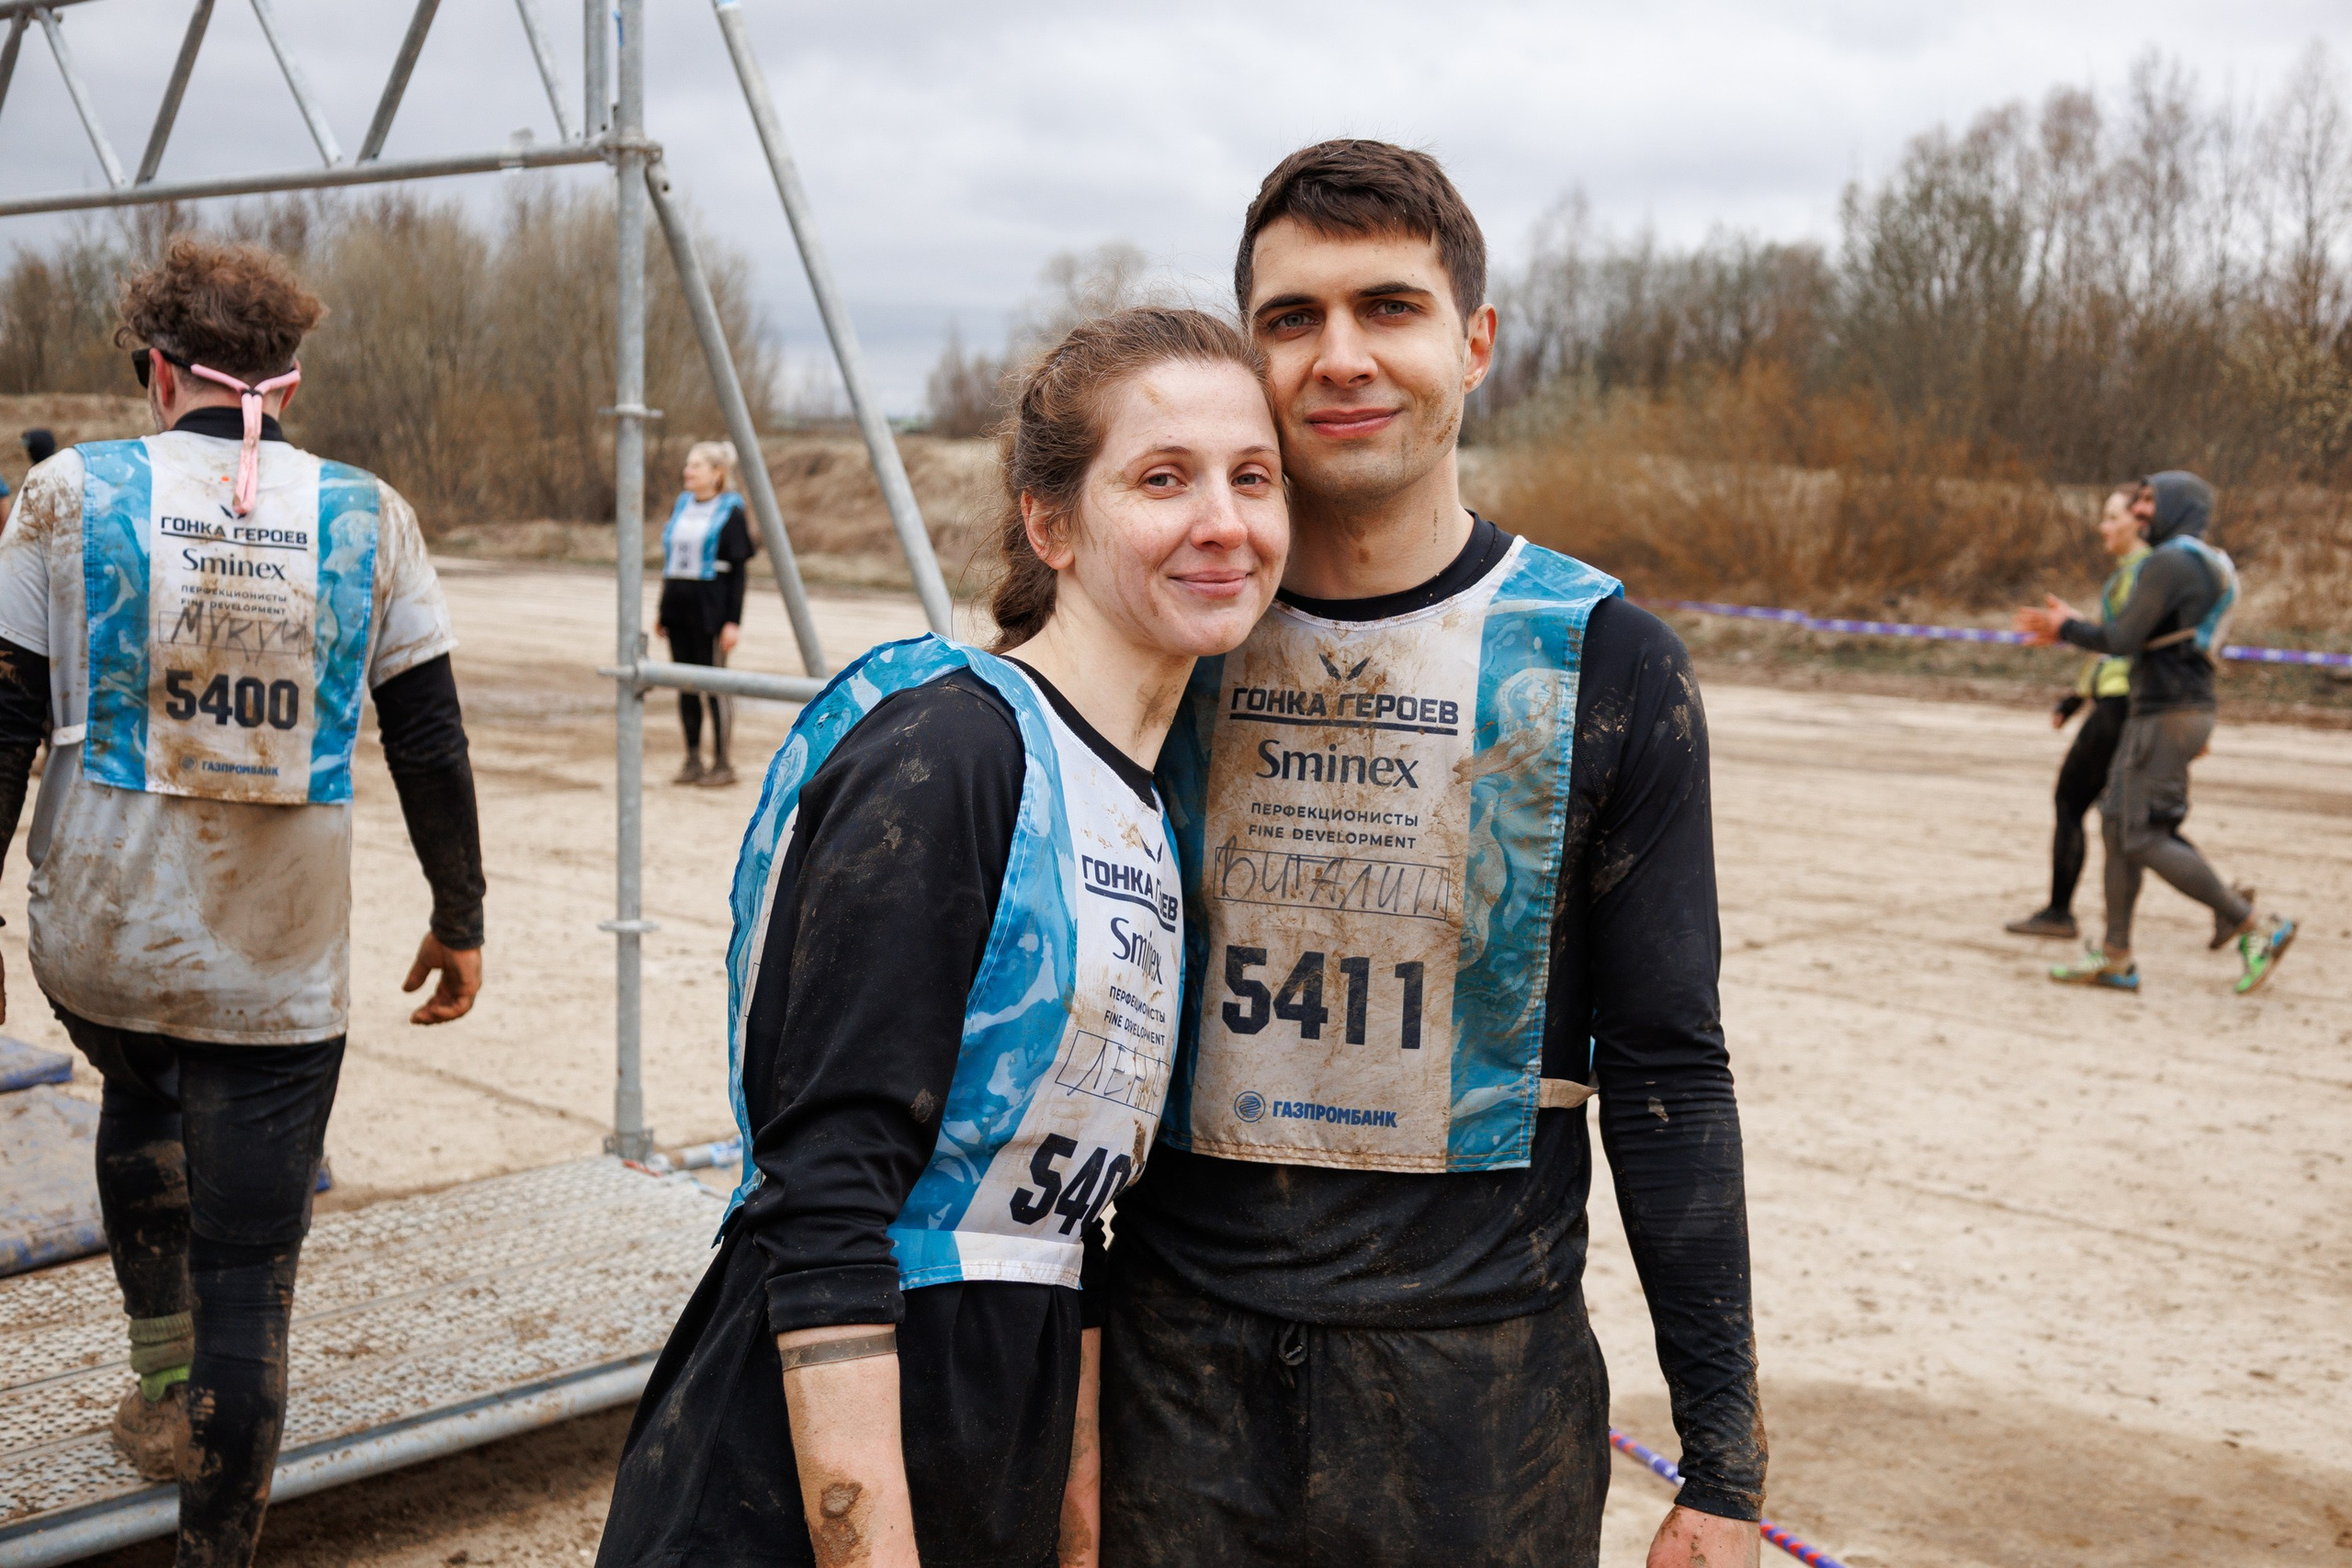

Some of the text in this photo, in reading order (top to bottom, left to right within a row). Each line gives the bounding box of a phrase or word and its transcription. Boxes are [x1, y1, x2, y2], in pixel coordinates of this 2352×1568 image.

[161, 516, 308, 545] ГОНКА ГЕРОЕВ
[182, 547, 286, 581] Sminex
[180, 585, 287, 603] ПЕРФЕКЦИОНИСТЫ
[180, 598, 286, 615] FINE DEVELOPMENT
[165, 668, 300, 730] 5400
[1230, 688, 1459, 725] ГОНКА ГЕРОЕВ
[202, 761, 278, 776] ГАЗПРОМБАНК
[1254, 739, 1419, 789] Sminex
[1250, 802, 1419, 827] ПЕРФЕКЦИОНИСТЫ
[1248, 824, 1417, 849] FINE DEVELOPMENT
[1081, 854, 1154, 900] ГОНКА
[1110, 917, 1163, 986] Smiex
[1222, 944, 1424, 1050] 5411
[1103, 1010, 1123, 1029] FINE
[1272, 1100, 1398, 1129] ГАЗПРОМБАНК
[1009, 1133, 1146, 1237] 540
